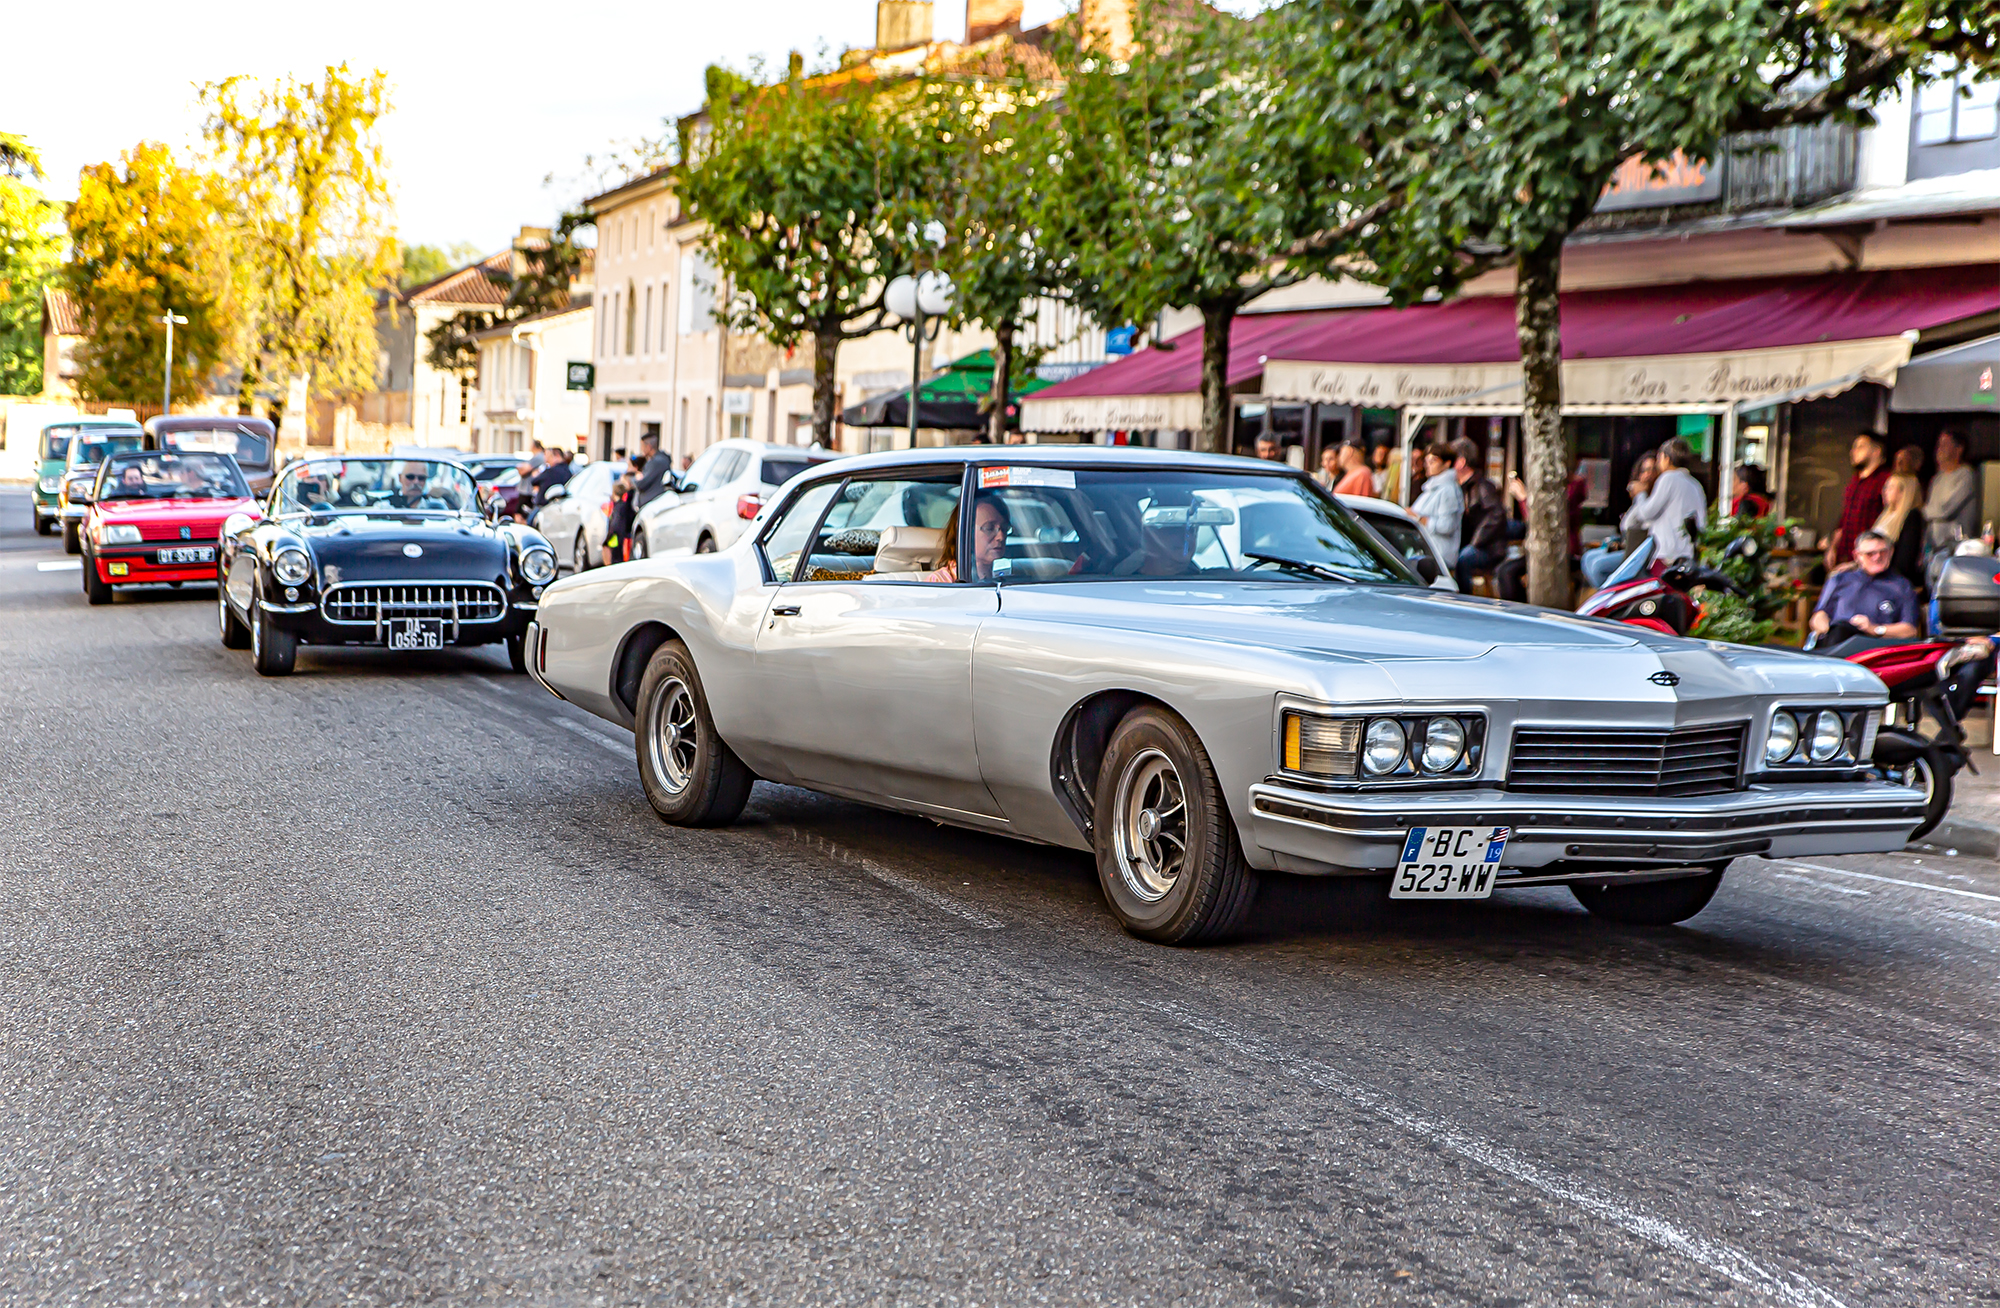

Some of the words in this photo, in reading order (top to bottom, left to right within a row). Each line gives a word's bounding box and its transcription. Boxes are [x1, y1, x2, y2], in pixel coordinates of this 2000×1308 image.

[1358, 373, 1380, 396] du
[1621, 367, 1668, 397] Bar
[395, 632, 437, 648] 056-TG
[1408, 849, 1416, 857] F
[1488, 847, 1502, 859] 19
[1399, 864, 1494, 892] 523-WW
